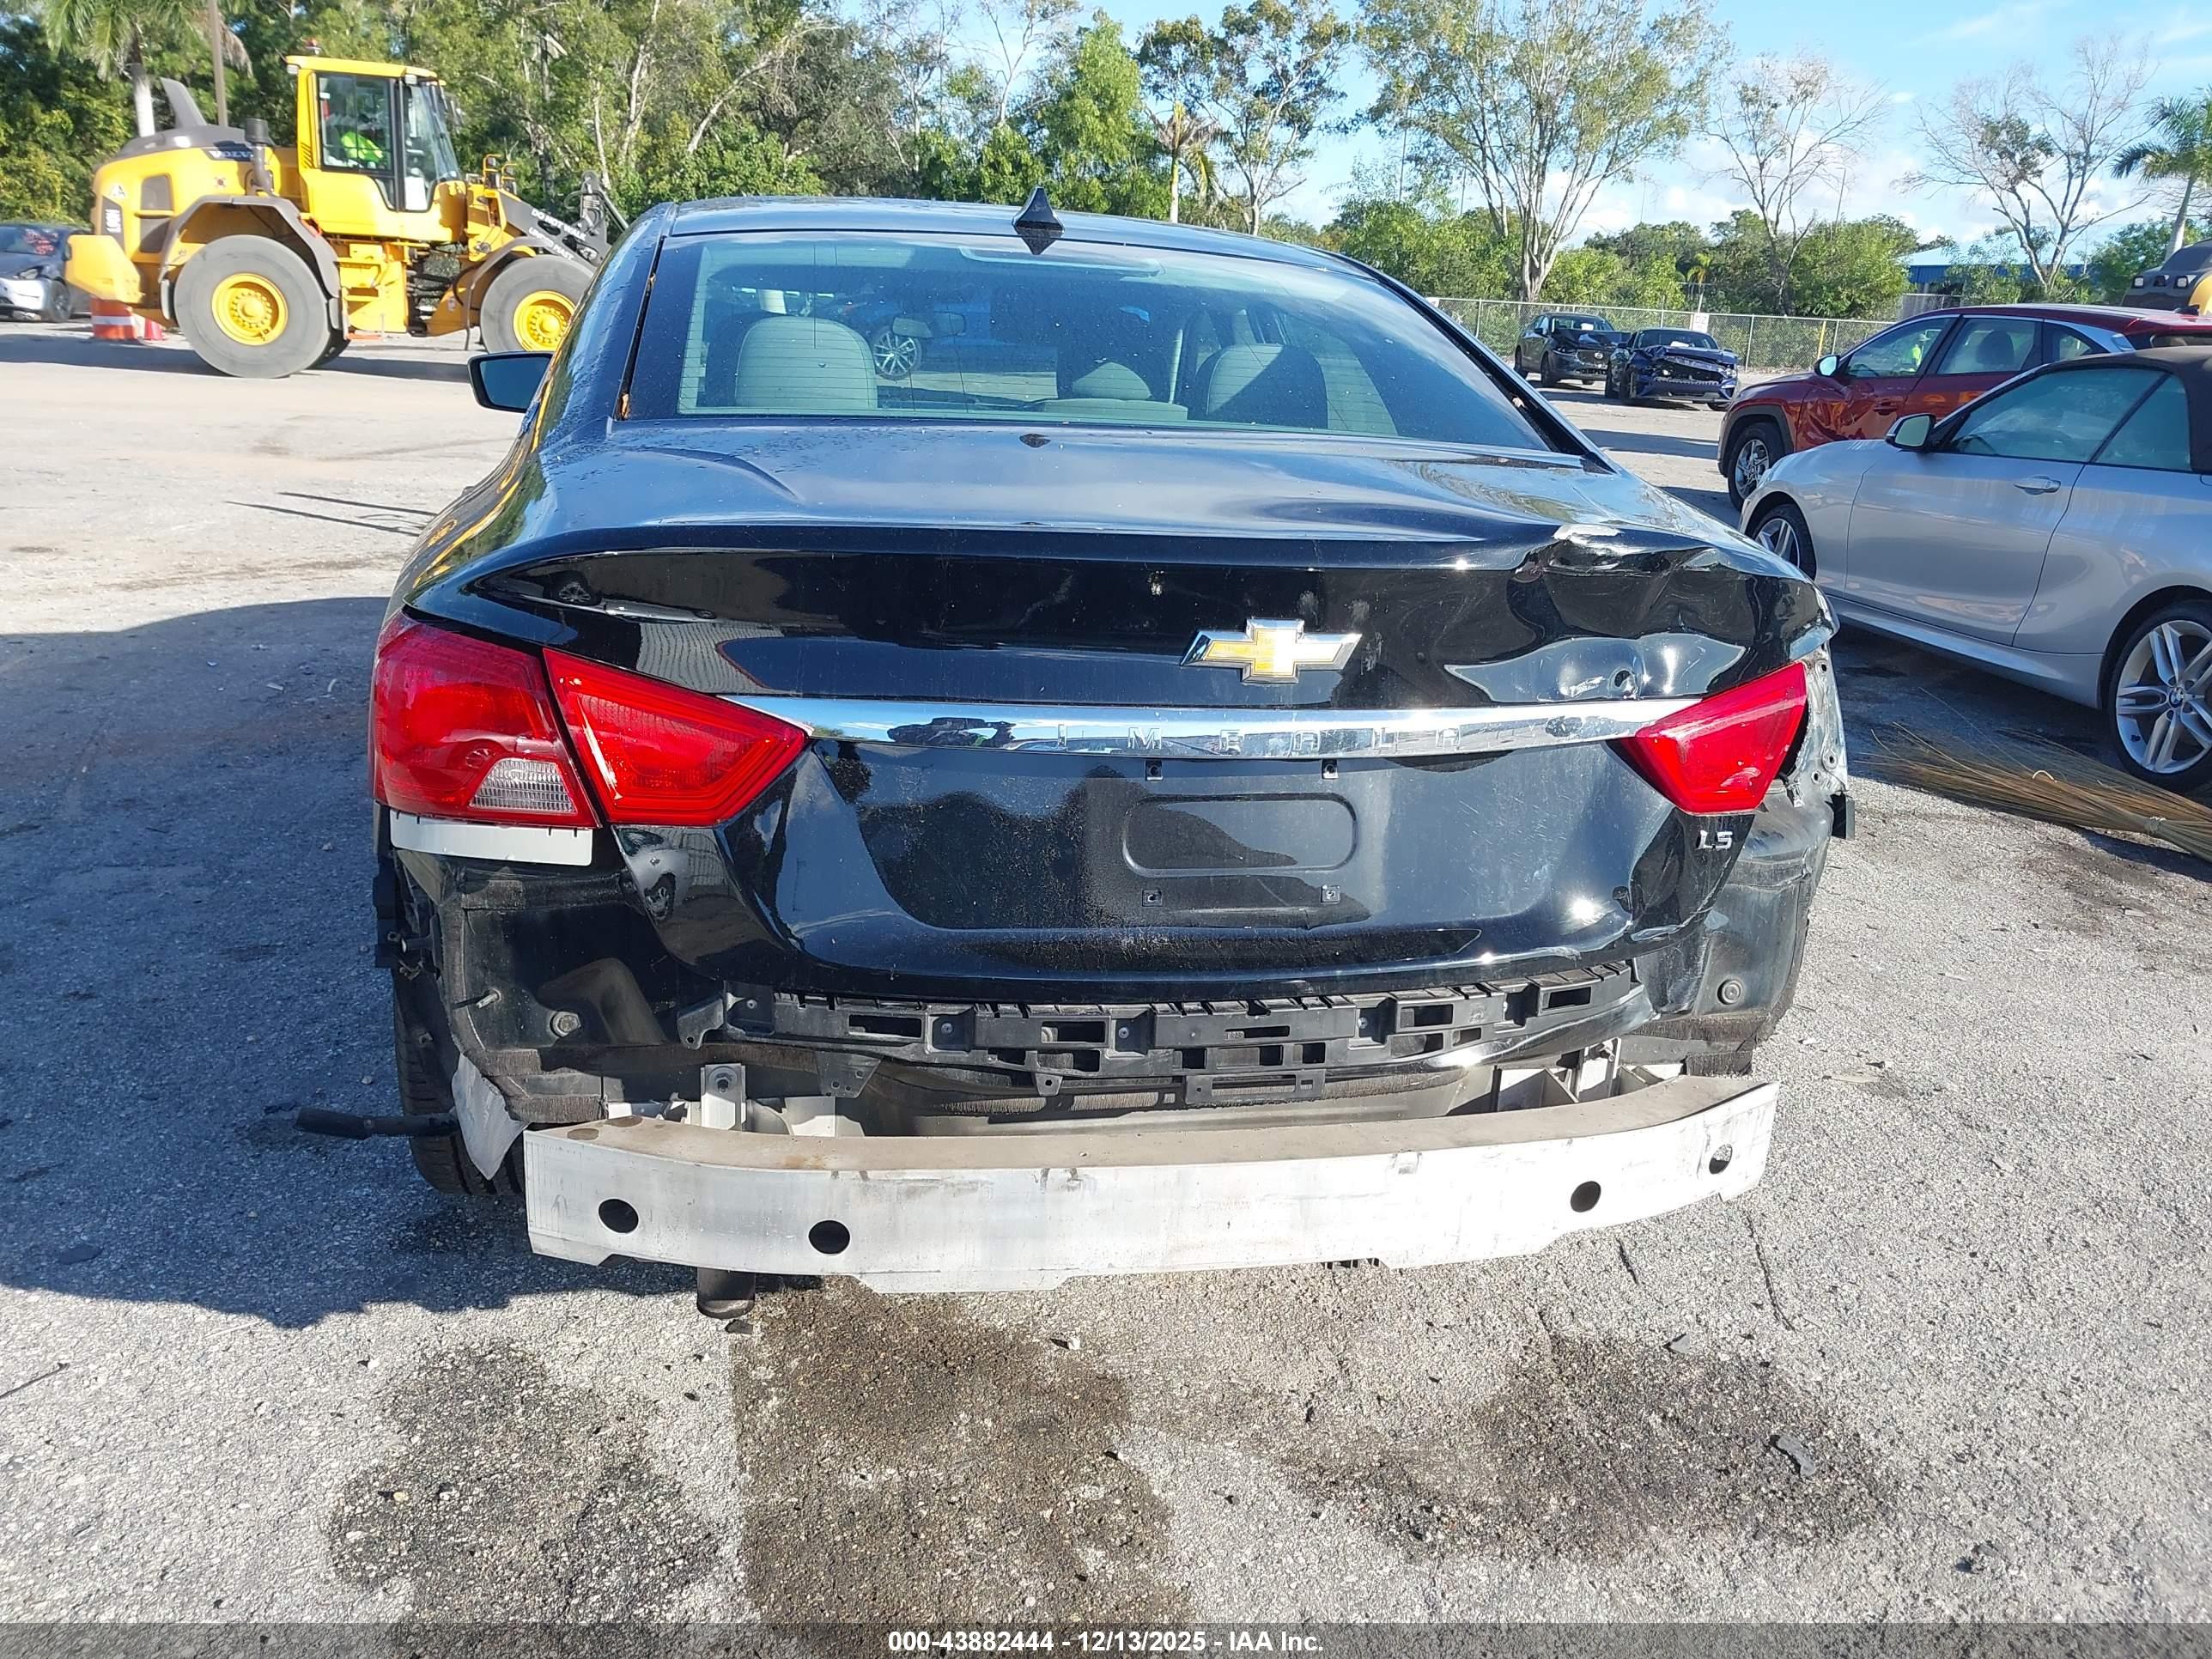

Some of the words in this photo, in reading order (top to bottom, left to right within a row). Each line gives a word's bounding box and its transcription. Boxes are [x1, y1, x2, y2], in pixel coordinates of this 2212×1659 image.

[209, 150, 254, 159] VOLV
[531, 208, 544, 219] DO
[545, 215, 564, 229] NOT
[564, 224, 587, 241] WALK
[553, 244, 574, 261] MAST
[1056, 723, 1462, 754] IMPALA
[1697, 830, 1733, 850] LS
